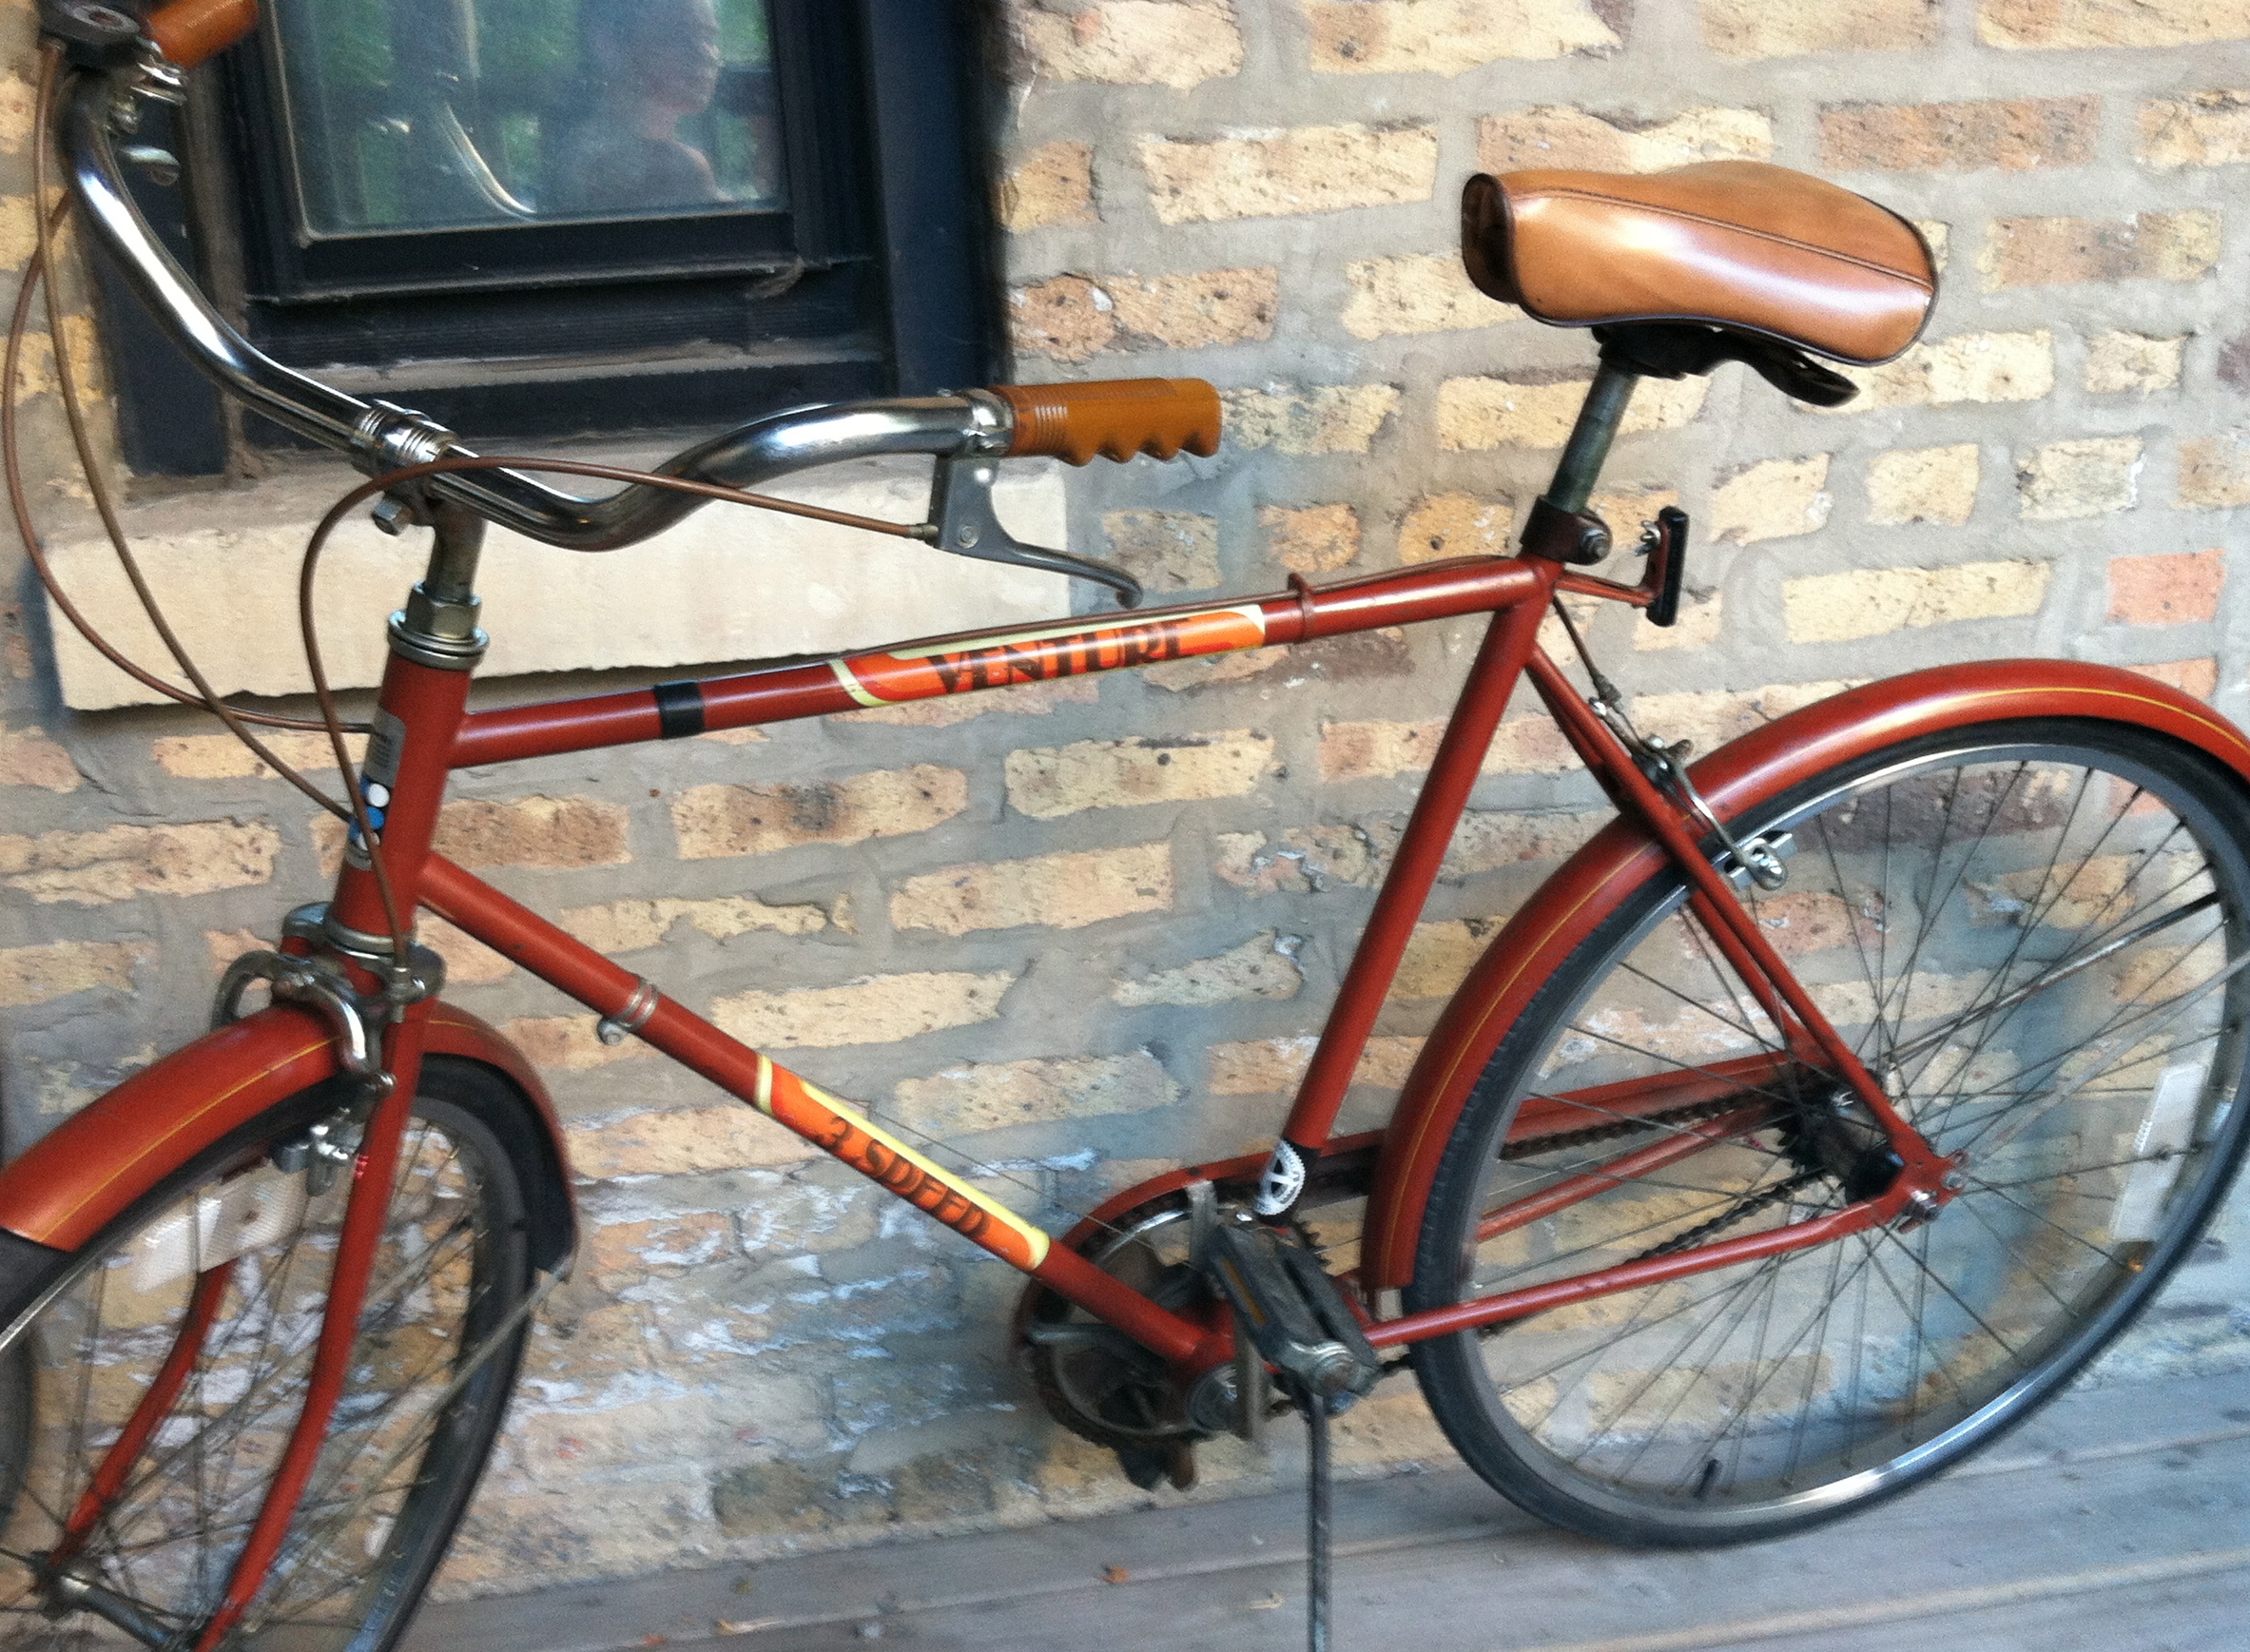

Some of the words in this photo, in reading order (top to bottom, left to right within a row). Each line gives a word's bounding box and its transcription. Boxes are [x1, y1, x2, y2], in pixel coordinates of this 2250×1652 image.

[926, 618, 1190, 694] VENTURE
[815, 1116, 854, 1152] 3
[861, 1138, 991, 1240] SPEED
